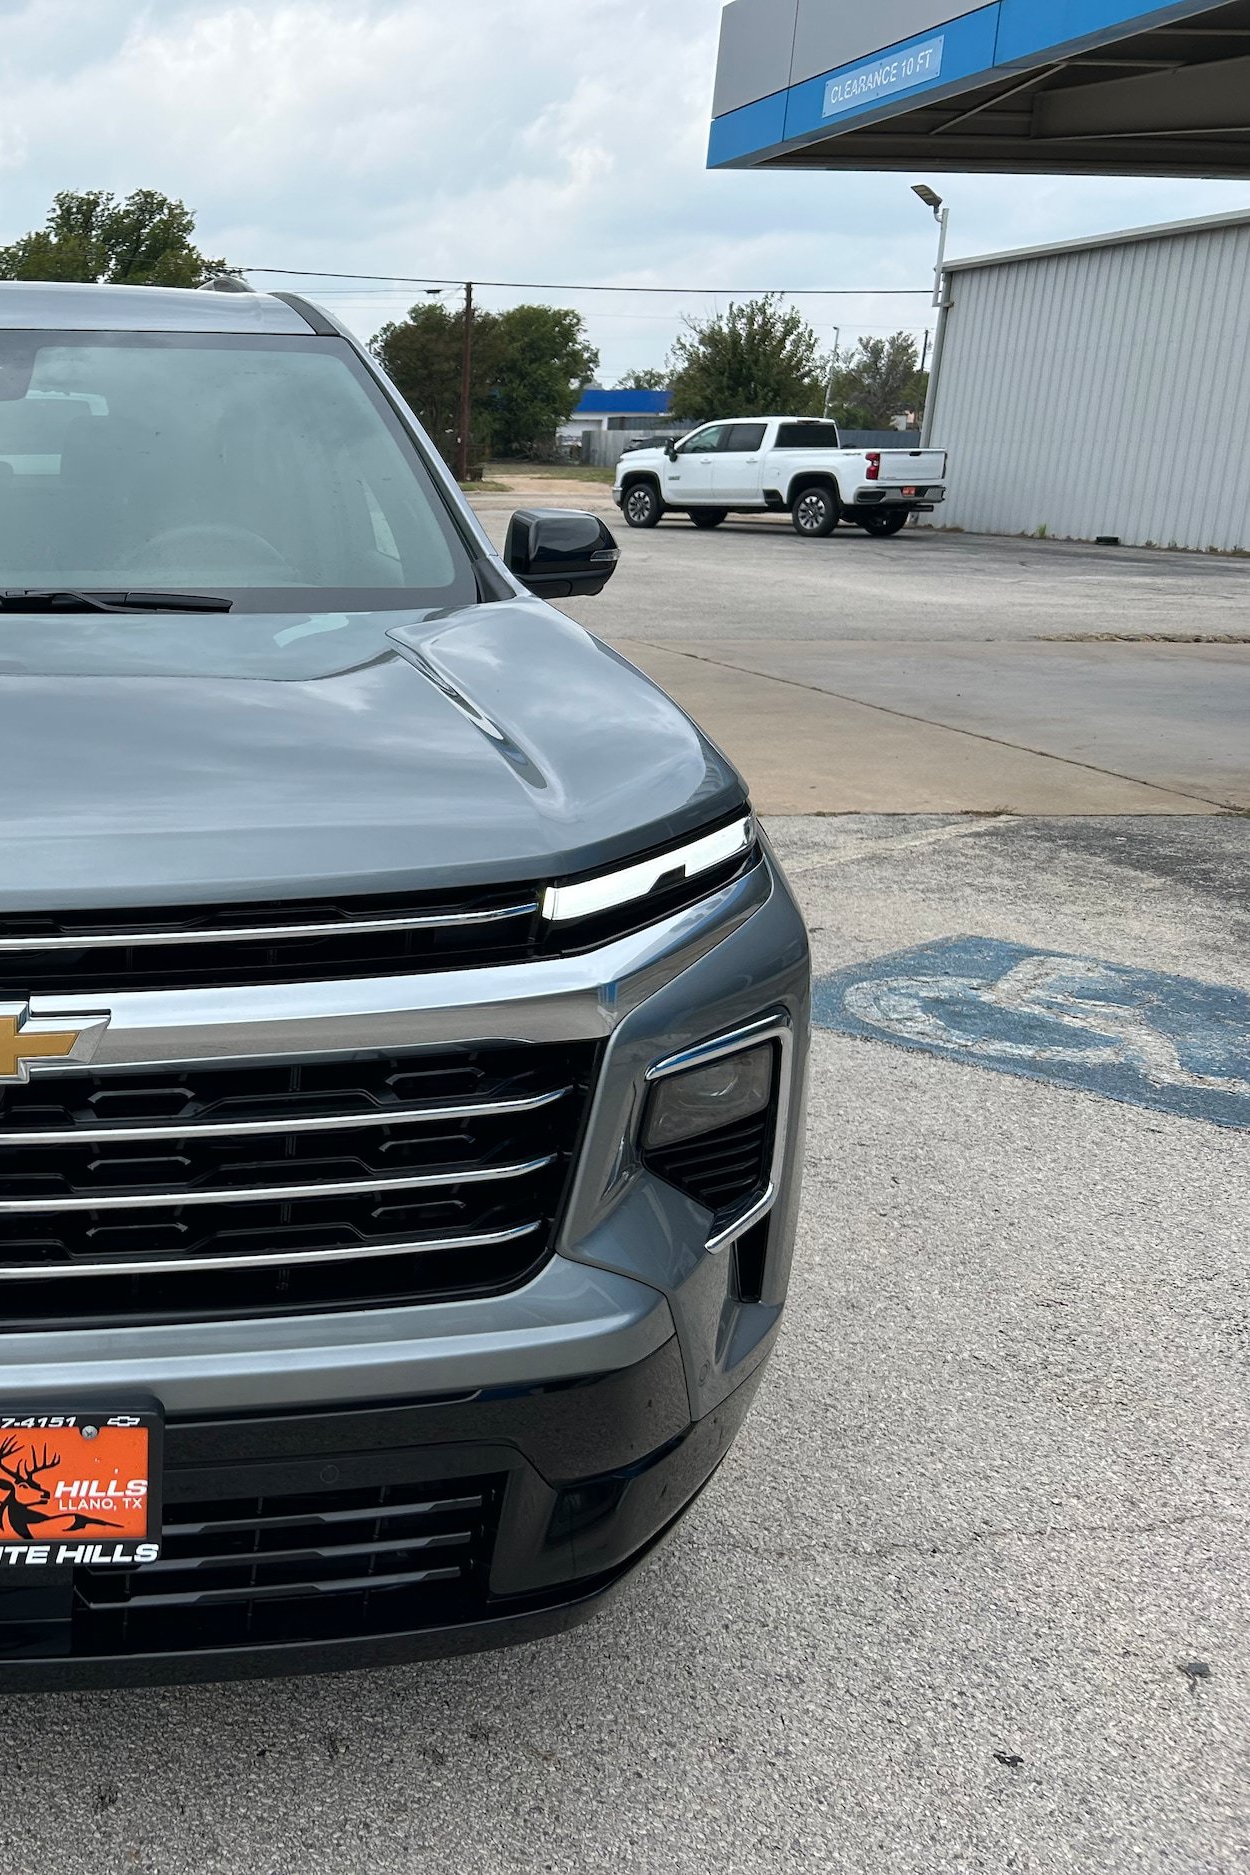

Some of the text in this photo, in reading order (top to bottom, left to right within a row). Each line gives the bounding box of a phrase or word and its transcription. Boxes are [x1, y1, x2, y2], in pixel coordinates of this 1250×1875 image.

[830, 49, 934, 104] CLEARANCE 10 FT
[54, 1479, 148, 1498] HILLS
[58, 1497, 143, 1511] LLANO, TX
[55, 1543, 160, 1565] HILLS
